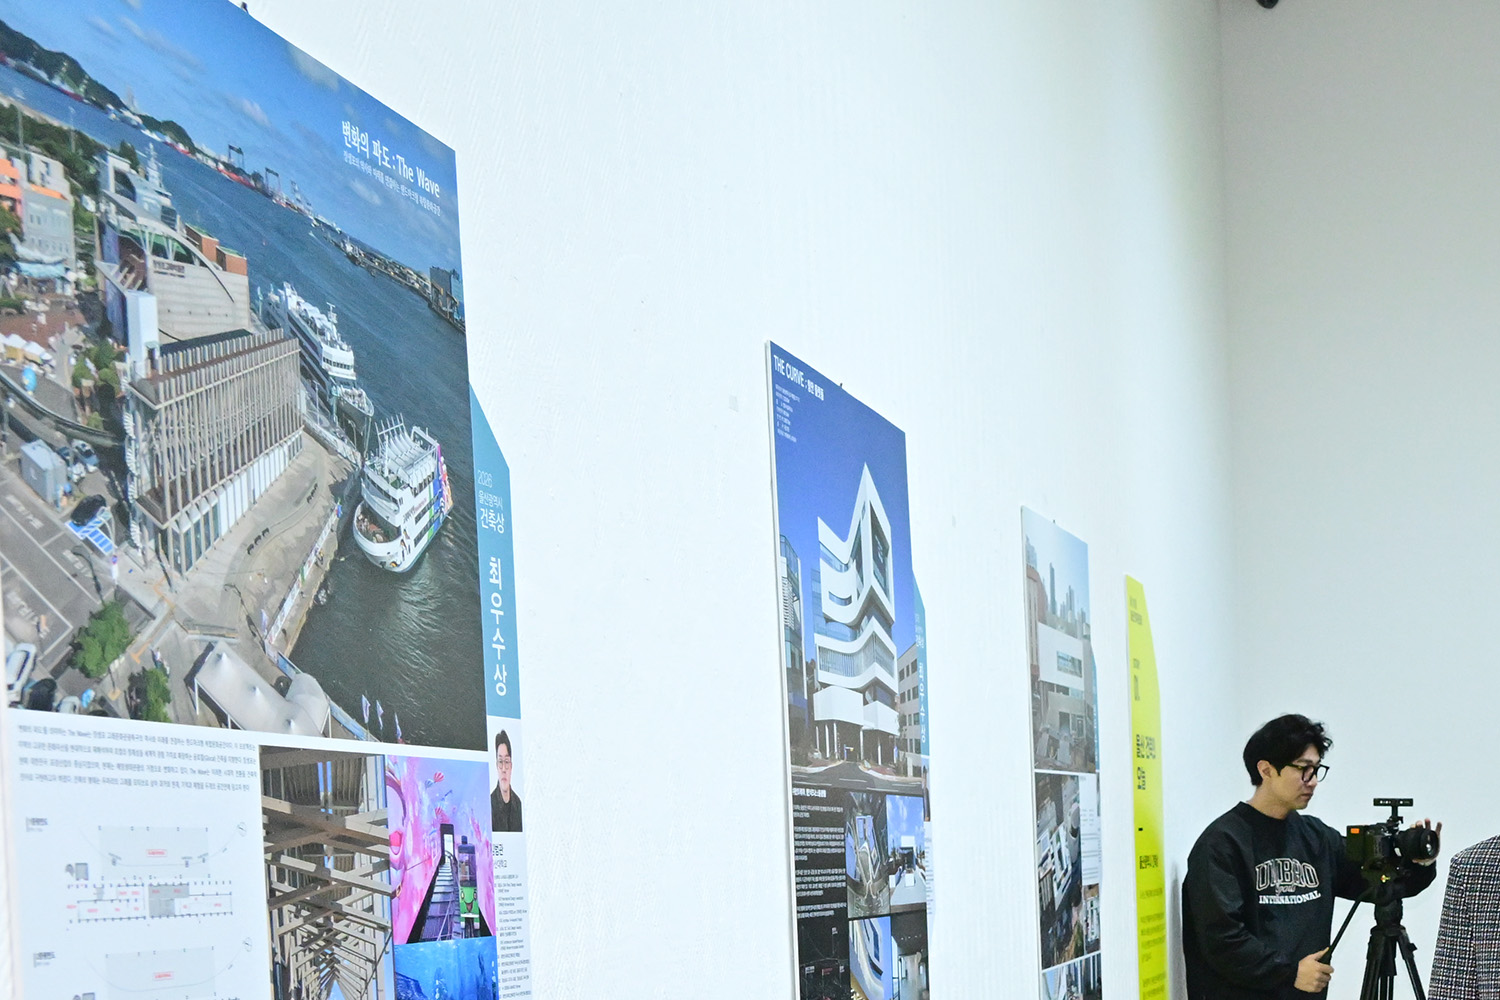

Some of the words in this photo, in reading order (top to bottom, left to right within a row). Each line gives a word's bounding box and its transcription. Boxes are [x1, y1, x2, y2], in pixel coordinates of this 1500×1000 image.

[342, 120, 370, 159] 변화의
[415, 165, 440, 198] Wave
[773, 354, 786, 376] THE
[785, 362, 805, 388] CURVE
[480, 508, 505, 534] 건축상
[489, 556, 507, 697] 최우수상
[1258, 890, 1322, 905] INTERNATIONAL
